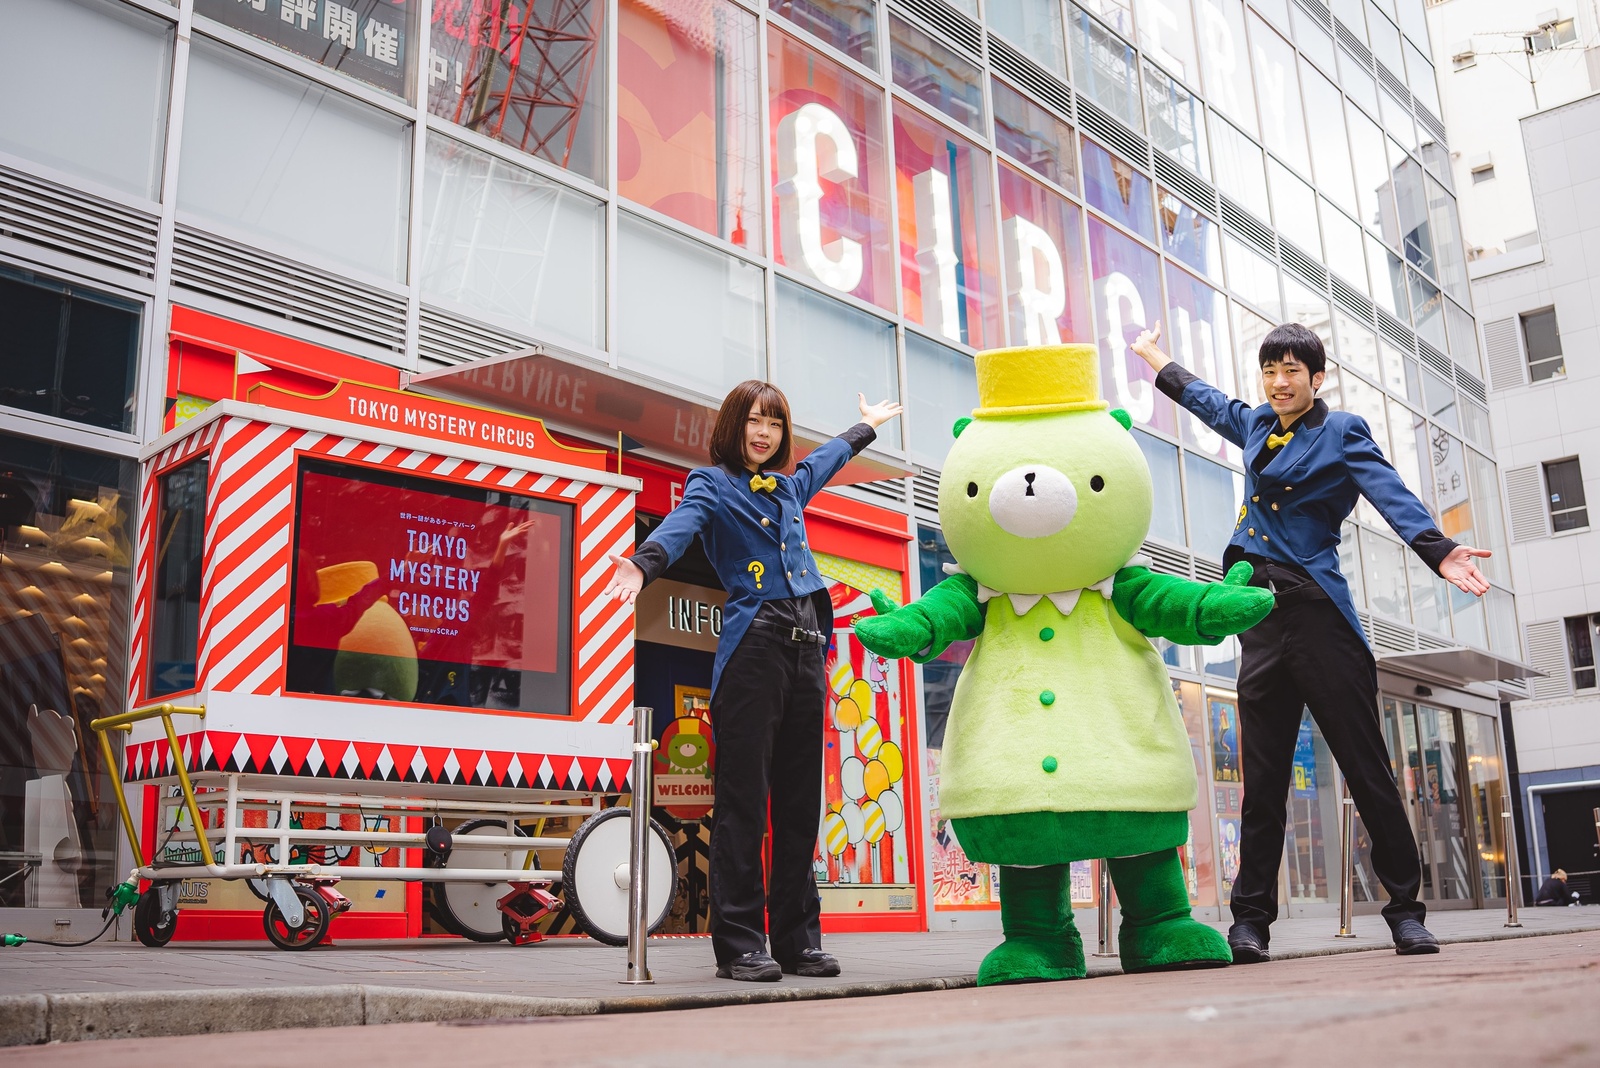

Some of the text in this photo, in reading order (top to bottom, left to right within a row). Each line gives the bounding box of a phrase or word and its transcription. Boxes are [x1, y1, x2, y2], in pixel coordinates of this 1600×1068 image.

[349, 396, 535, 449] TOKYO MYSTERY CIRCUS
[407, 529, 467, 560] TOKYO
[389, 558, 480, 593] MYSTERY
[398, 591, 470, 622] CIRCUS
[437, 628, 459, 636] SCRAP
